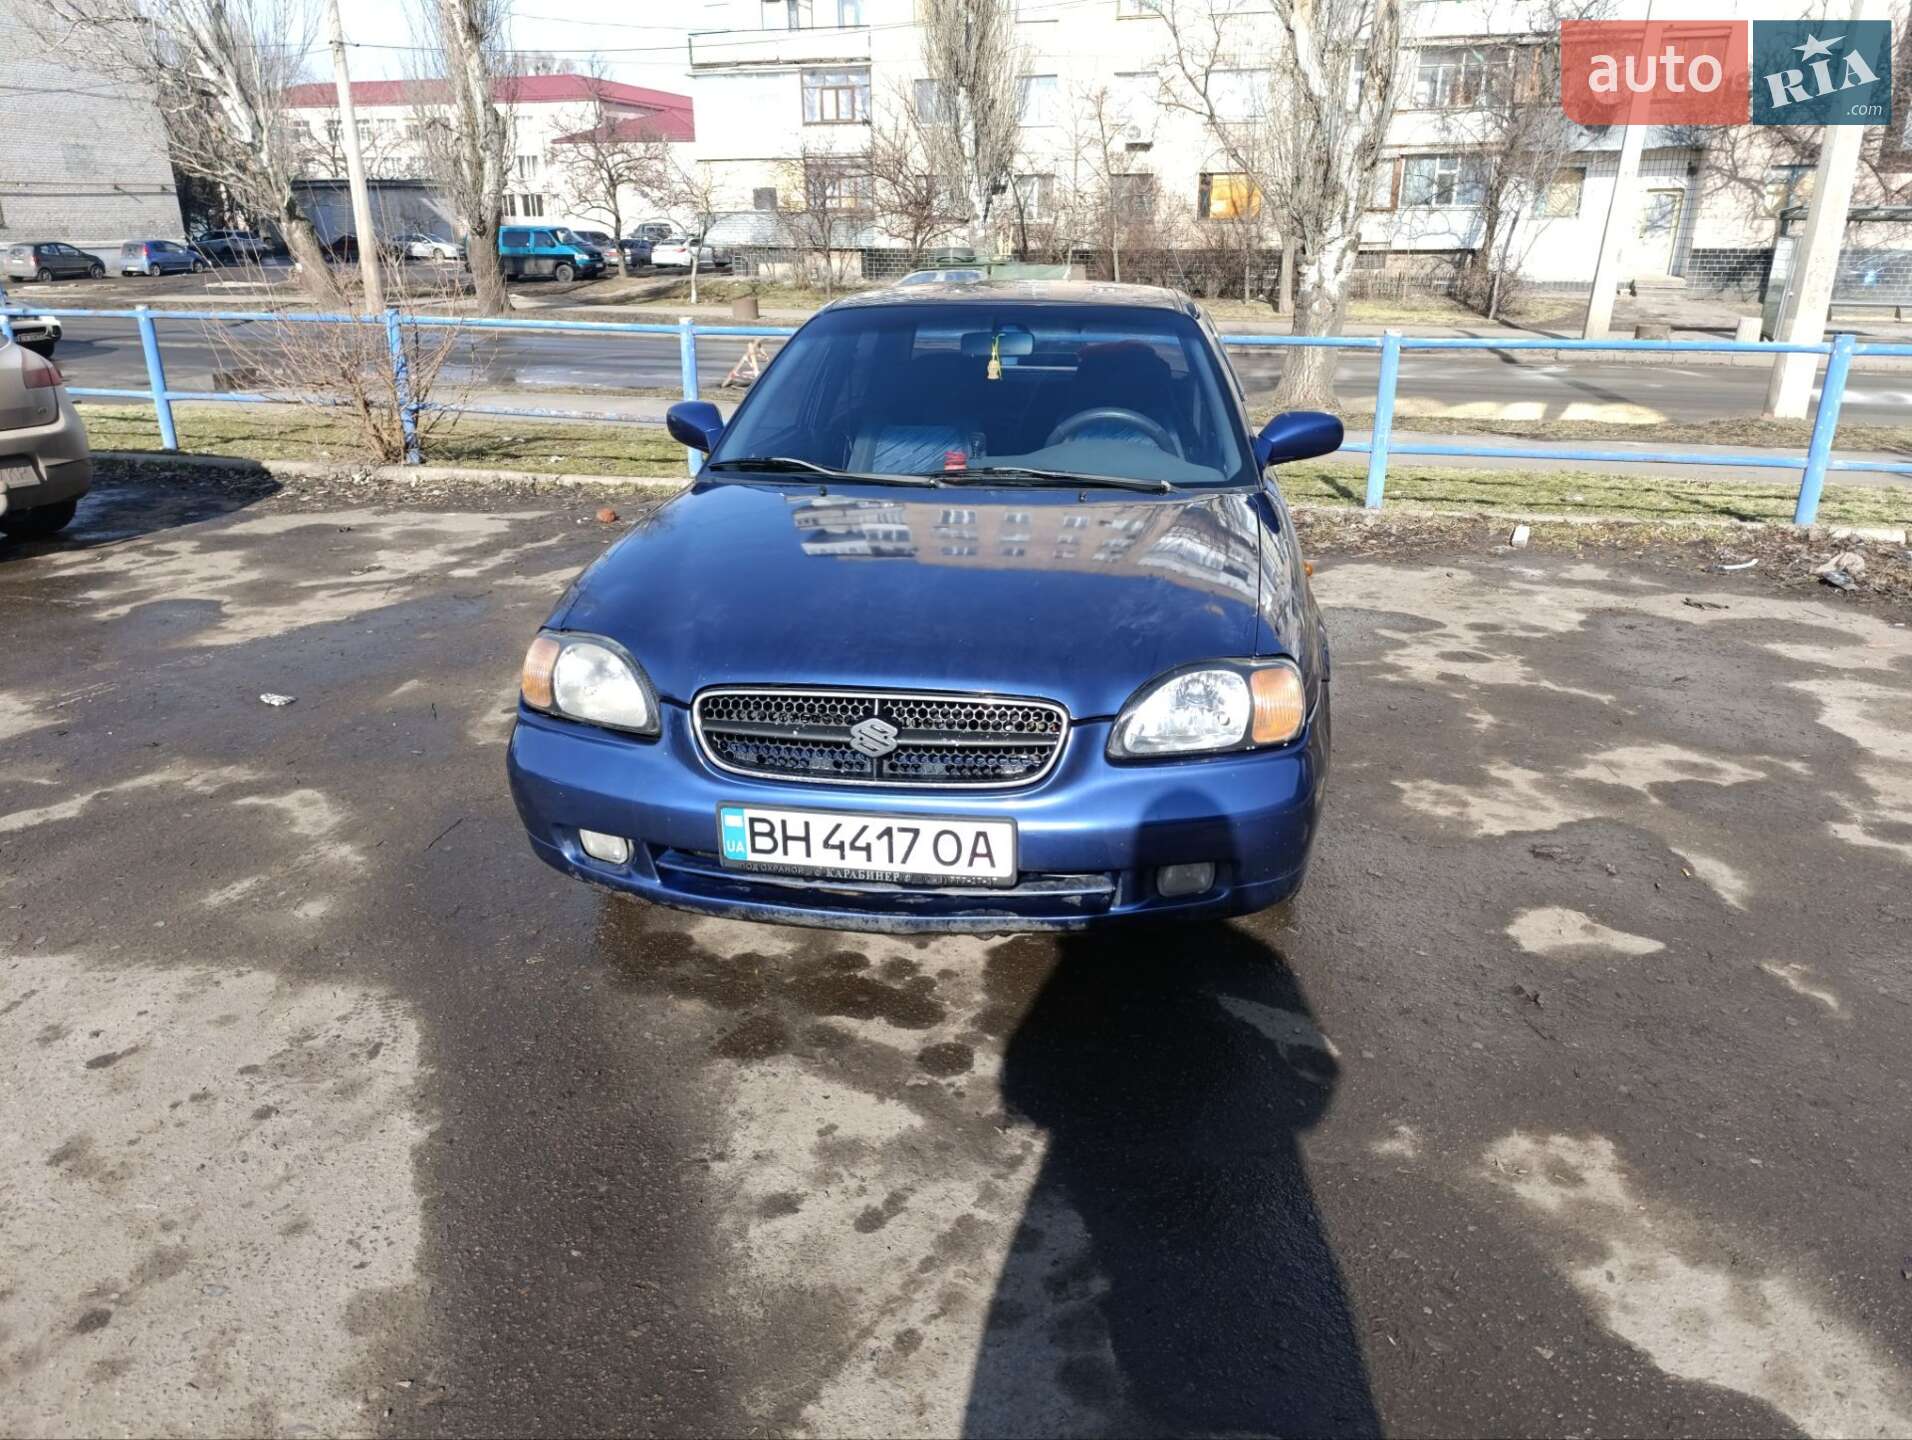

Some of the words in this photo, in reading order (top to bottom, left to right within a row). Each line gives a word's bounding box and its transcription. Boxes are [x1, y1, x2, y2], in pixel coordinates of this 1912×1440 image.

[726, 841, 746, 854] UA
[748, 816, 812, 858] BH
[822, 822, 921, 865] 4417
[932, 829, 996, 868] OA
[826, 867, 900, 882] КАРАБИНЕР
